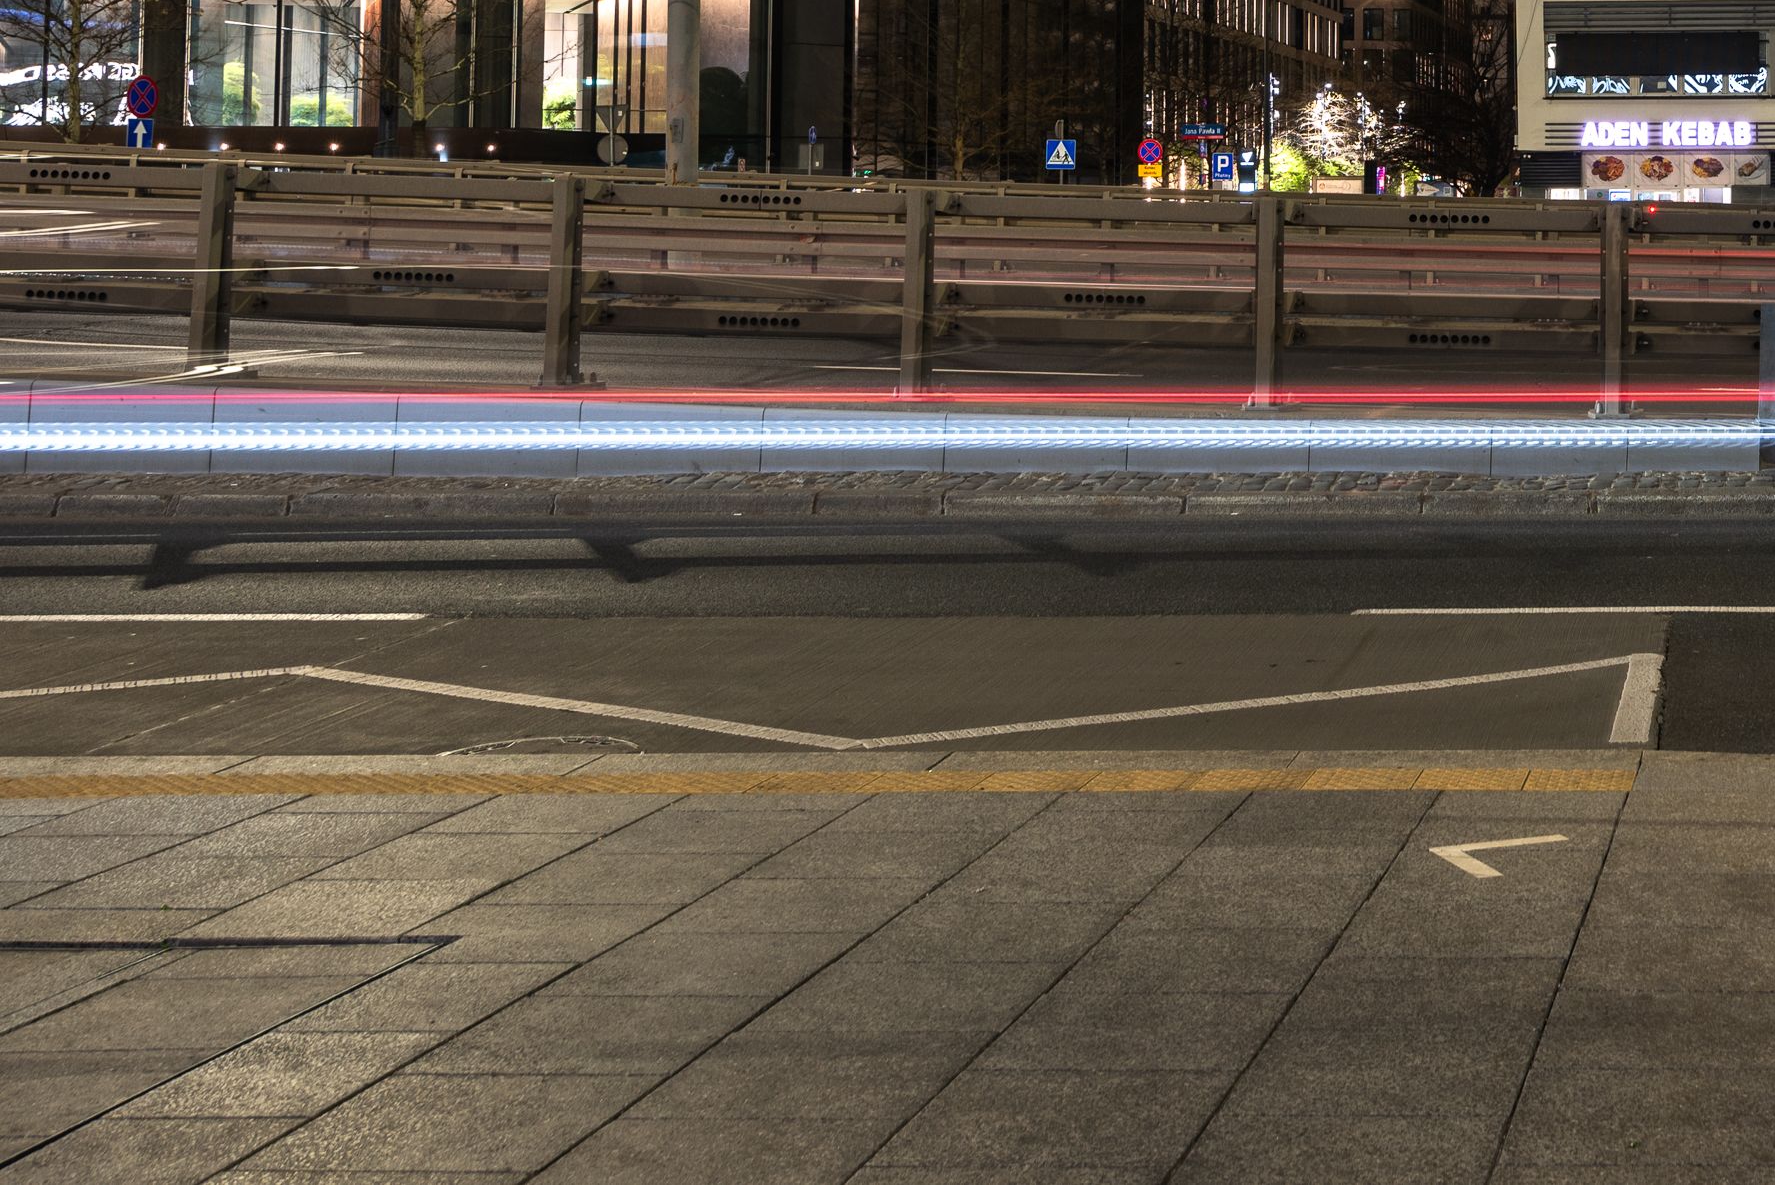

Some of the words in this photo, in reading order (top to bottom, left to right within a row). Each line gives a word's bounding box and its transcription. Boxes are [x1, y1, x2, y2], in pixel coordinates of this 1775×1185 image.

[1580, 121, 1649, 147] ADEN
[1662, 121, 1753, 147] KEBAB
[1217, 155, 1229, 172] P
